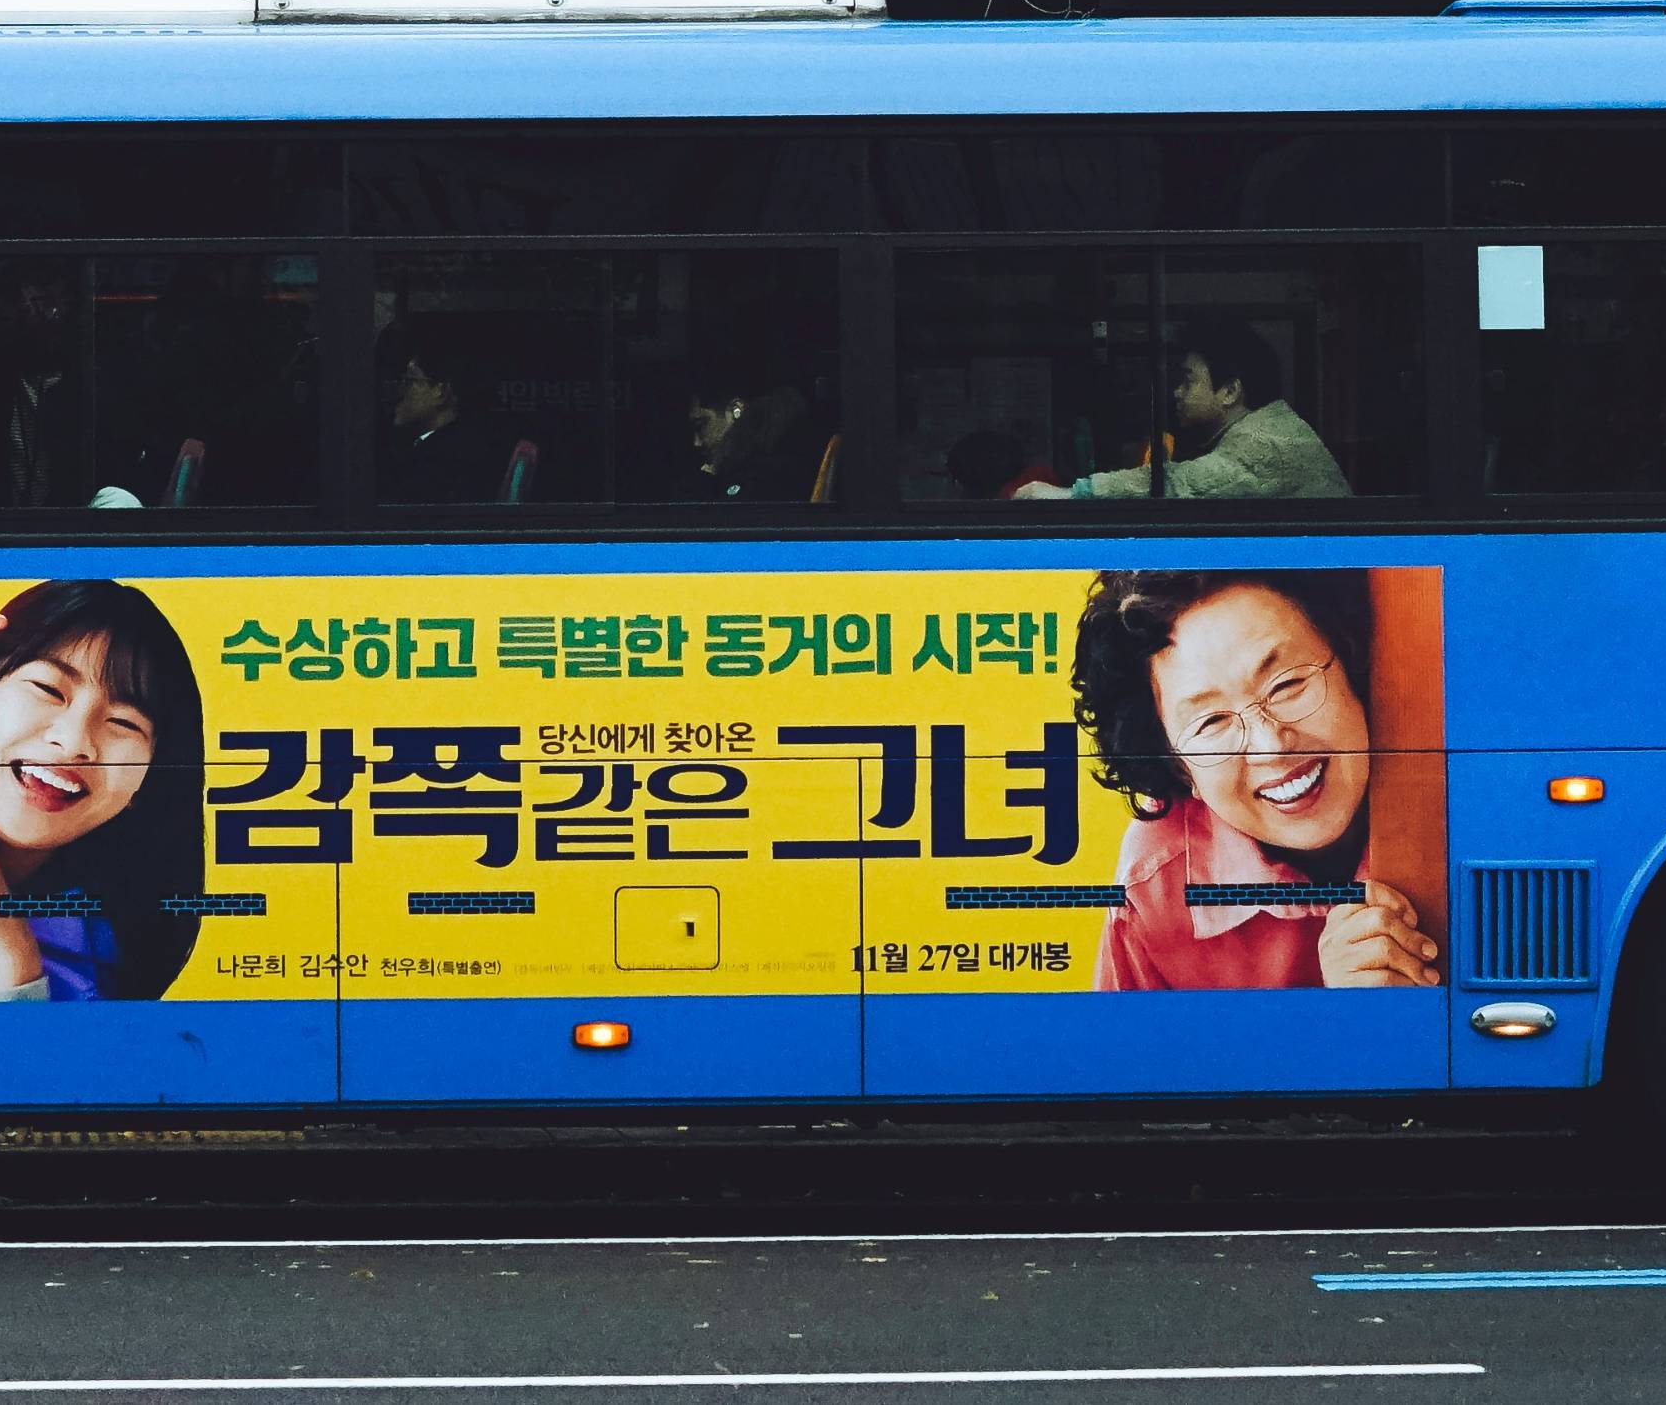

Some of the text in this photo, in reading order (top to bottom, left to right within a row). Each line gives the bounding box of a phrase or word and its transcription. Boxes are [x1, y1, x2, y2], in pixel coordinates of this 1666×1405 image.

[220, 611, 1058, 682] 수상하고 특별한 동거의 시작!
[539, 721, 756, 755] 당신에게 찾아온
[771, 721, 1080, 867] 그녀
[216, 953, 287, 979] 나문희
[299, 952, 369, 978] 김수안
[850, 942, 909, 973] 11월
[918, 941, 980, 972] 27일
[988, 941, 1072, 973] 대개봉
